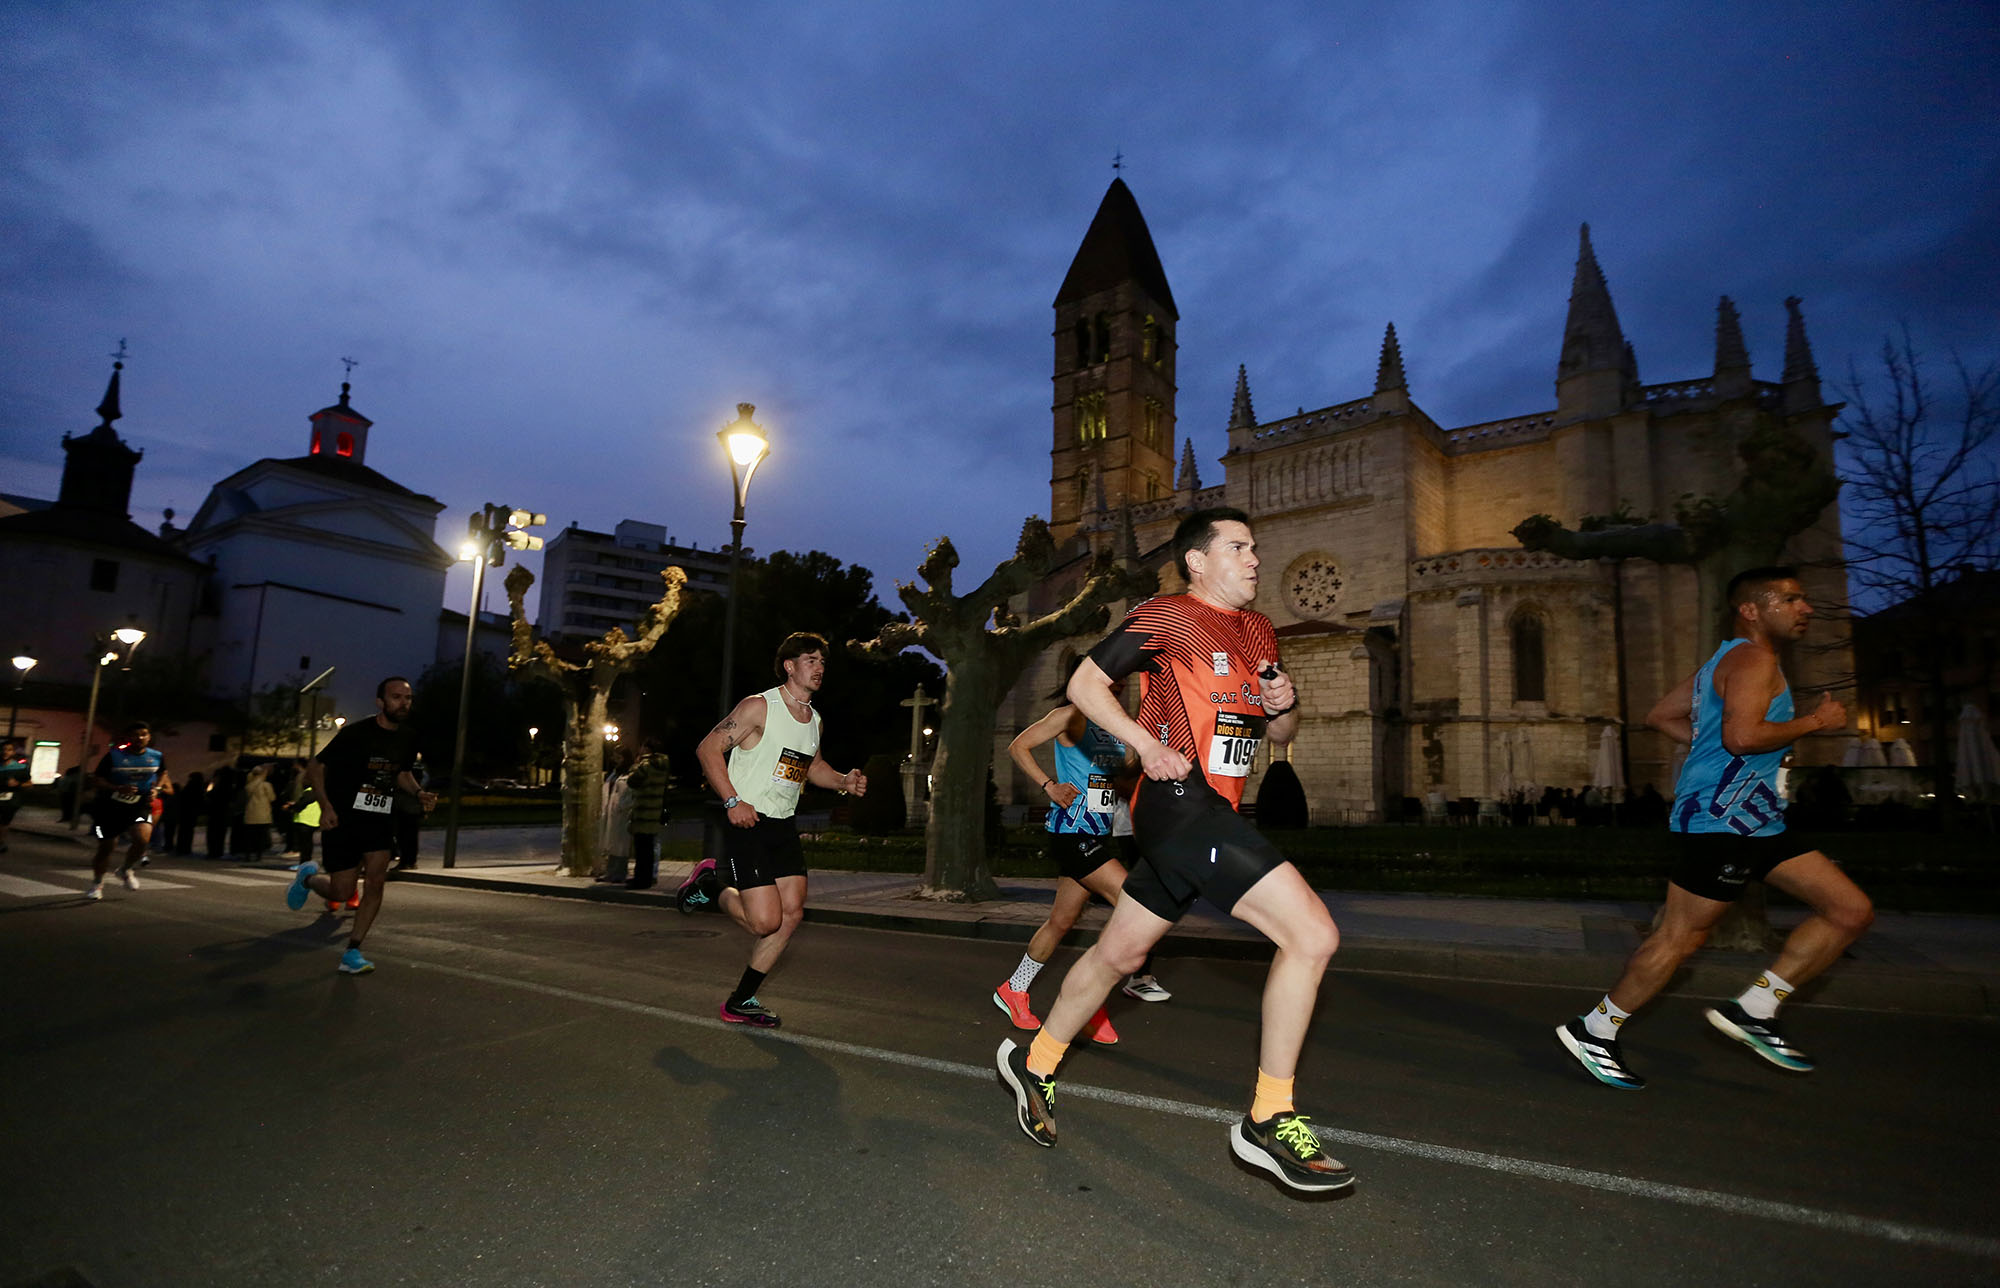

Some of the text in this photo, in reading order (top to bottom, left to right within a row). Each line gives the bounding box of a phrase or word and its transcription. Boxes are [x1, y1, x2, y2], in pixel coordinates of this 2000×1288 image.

[1217, 723, 1234, 736] RÍOS
[1235, 727, 1243, 737] DE
[364, 793, 387, 808] 956
